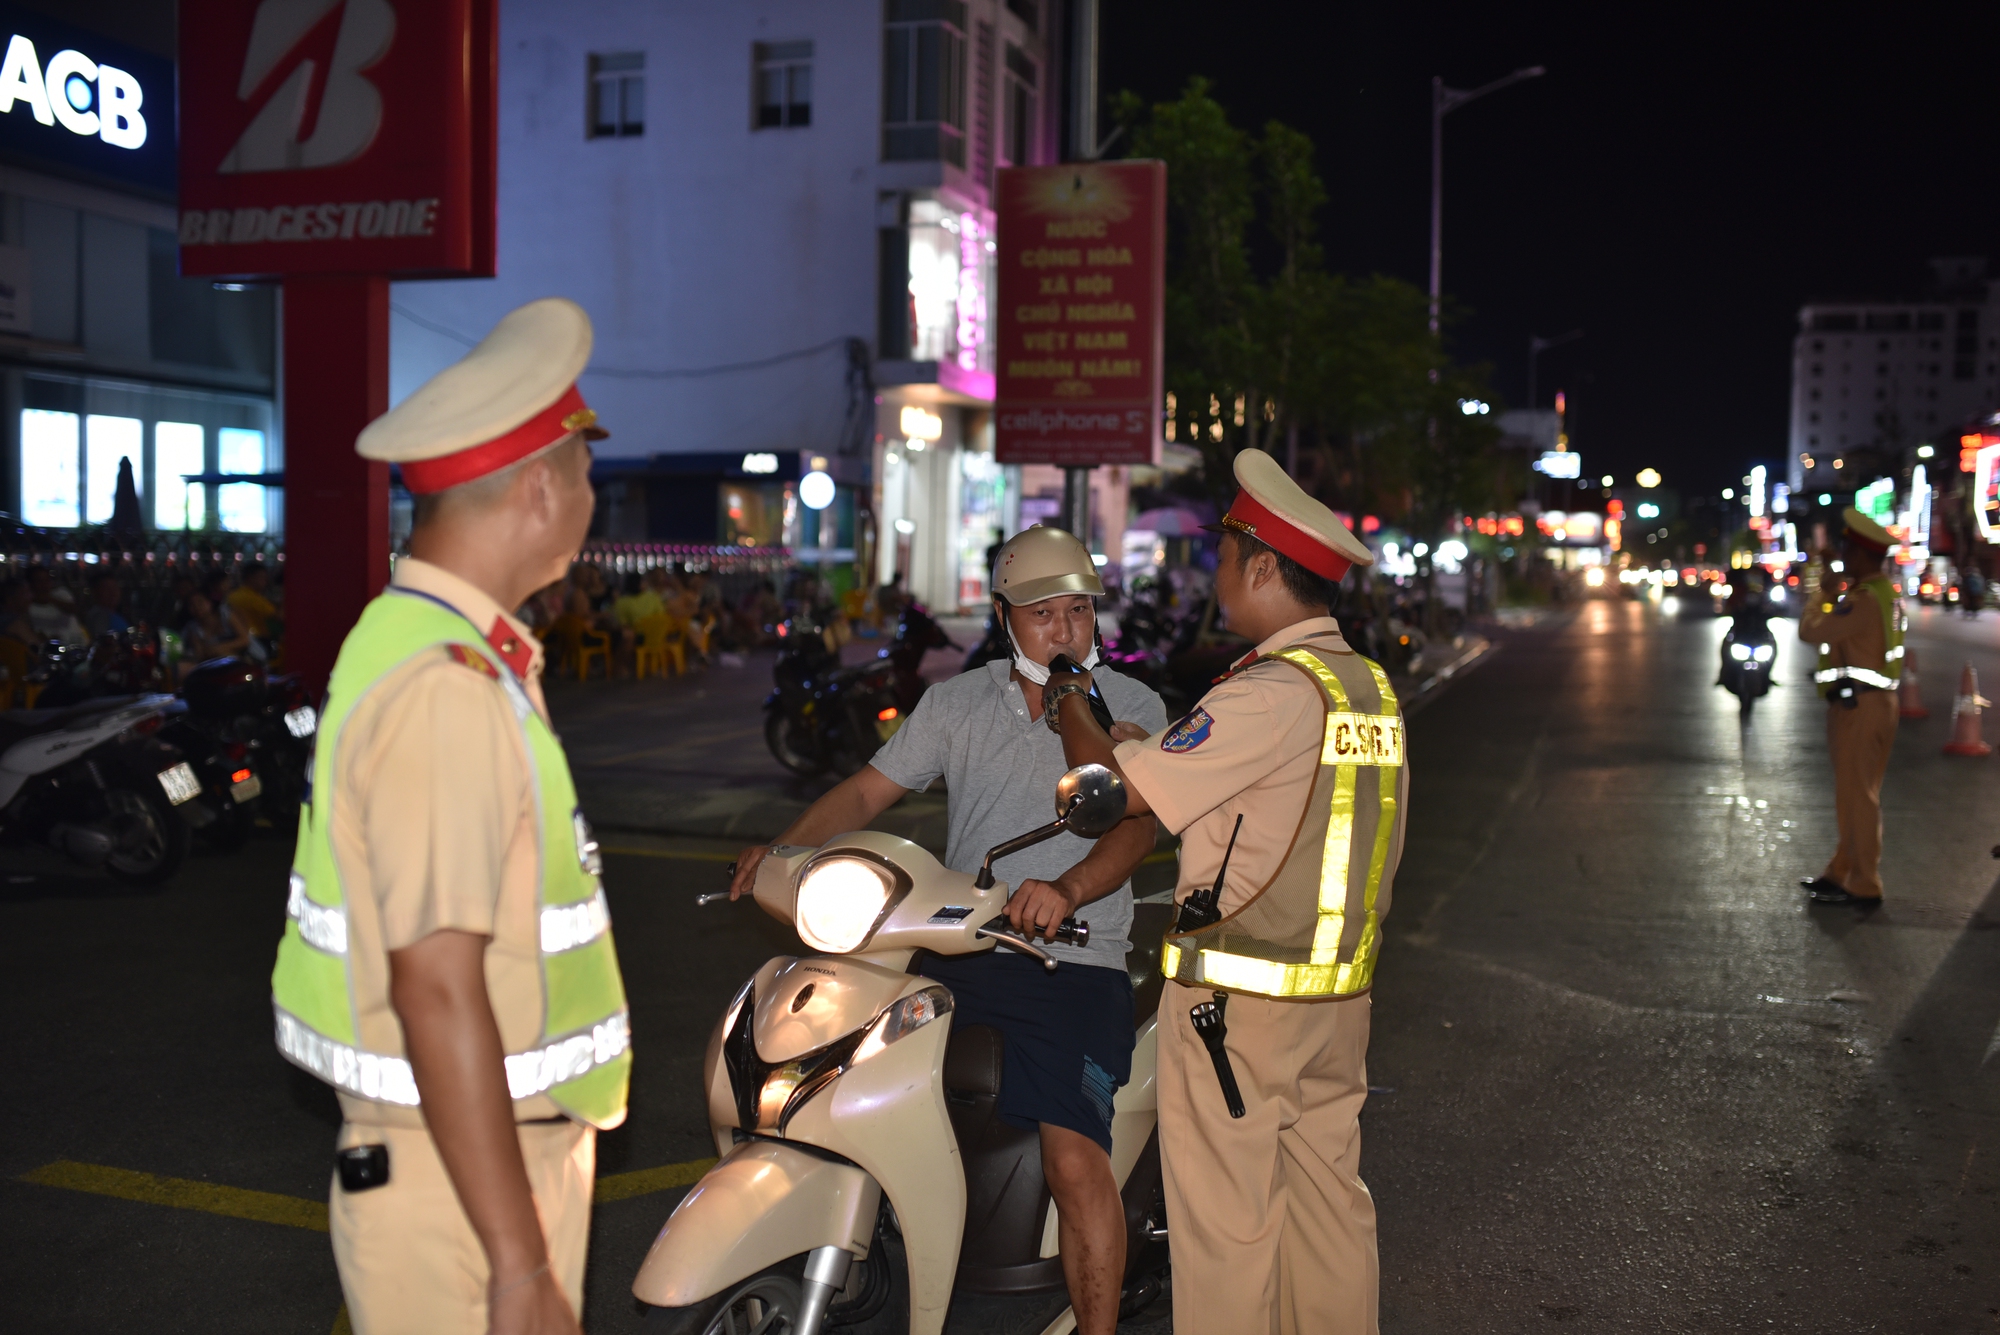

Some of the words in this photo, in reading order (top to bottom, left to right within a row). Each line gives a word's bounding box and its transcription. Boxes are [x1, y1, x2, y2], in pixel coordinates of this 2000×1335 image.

[0, 34, 147, 150] ACB
[179, 199, 438, 246] BRIDGESTONE
[1075, 332, 1127, 349] NAM
[804, 966, 836, 976] HONDA
